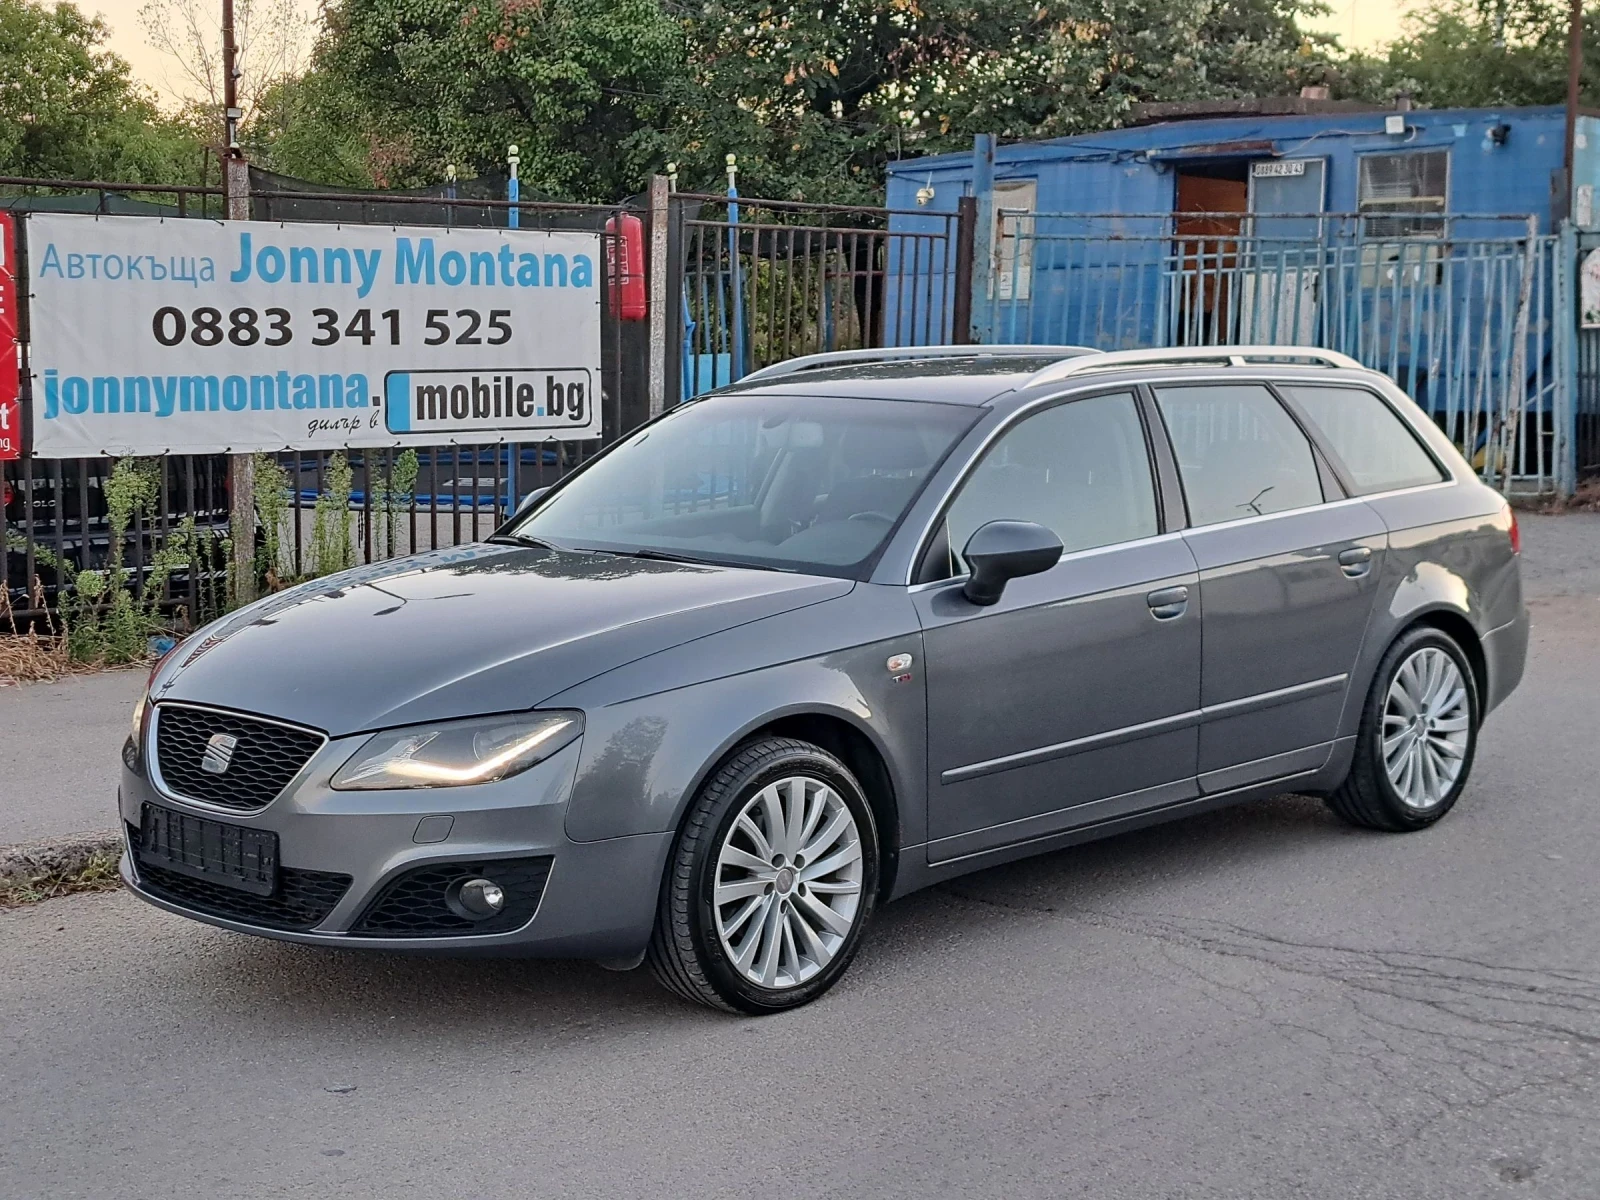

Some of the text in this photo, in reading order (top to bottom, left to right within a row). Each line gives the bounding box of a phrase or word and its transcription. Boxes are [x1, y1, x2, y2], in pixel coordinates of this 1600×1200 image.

[40, 243, 215, 288] Автокъща
[230, 232, 382, 299] Jonny
[395, 237, 593, 288] Montana
[152, 306, 513, 347] 0883 341 525
[416, 375, 585, 421] mobile.bg
[307, 415, 361, 438] дилър
